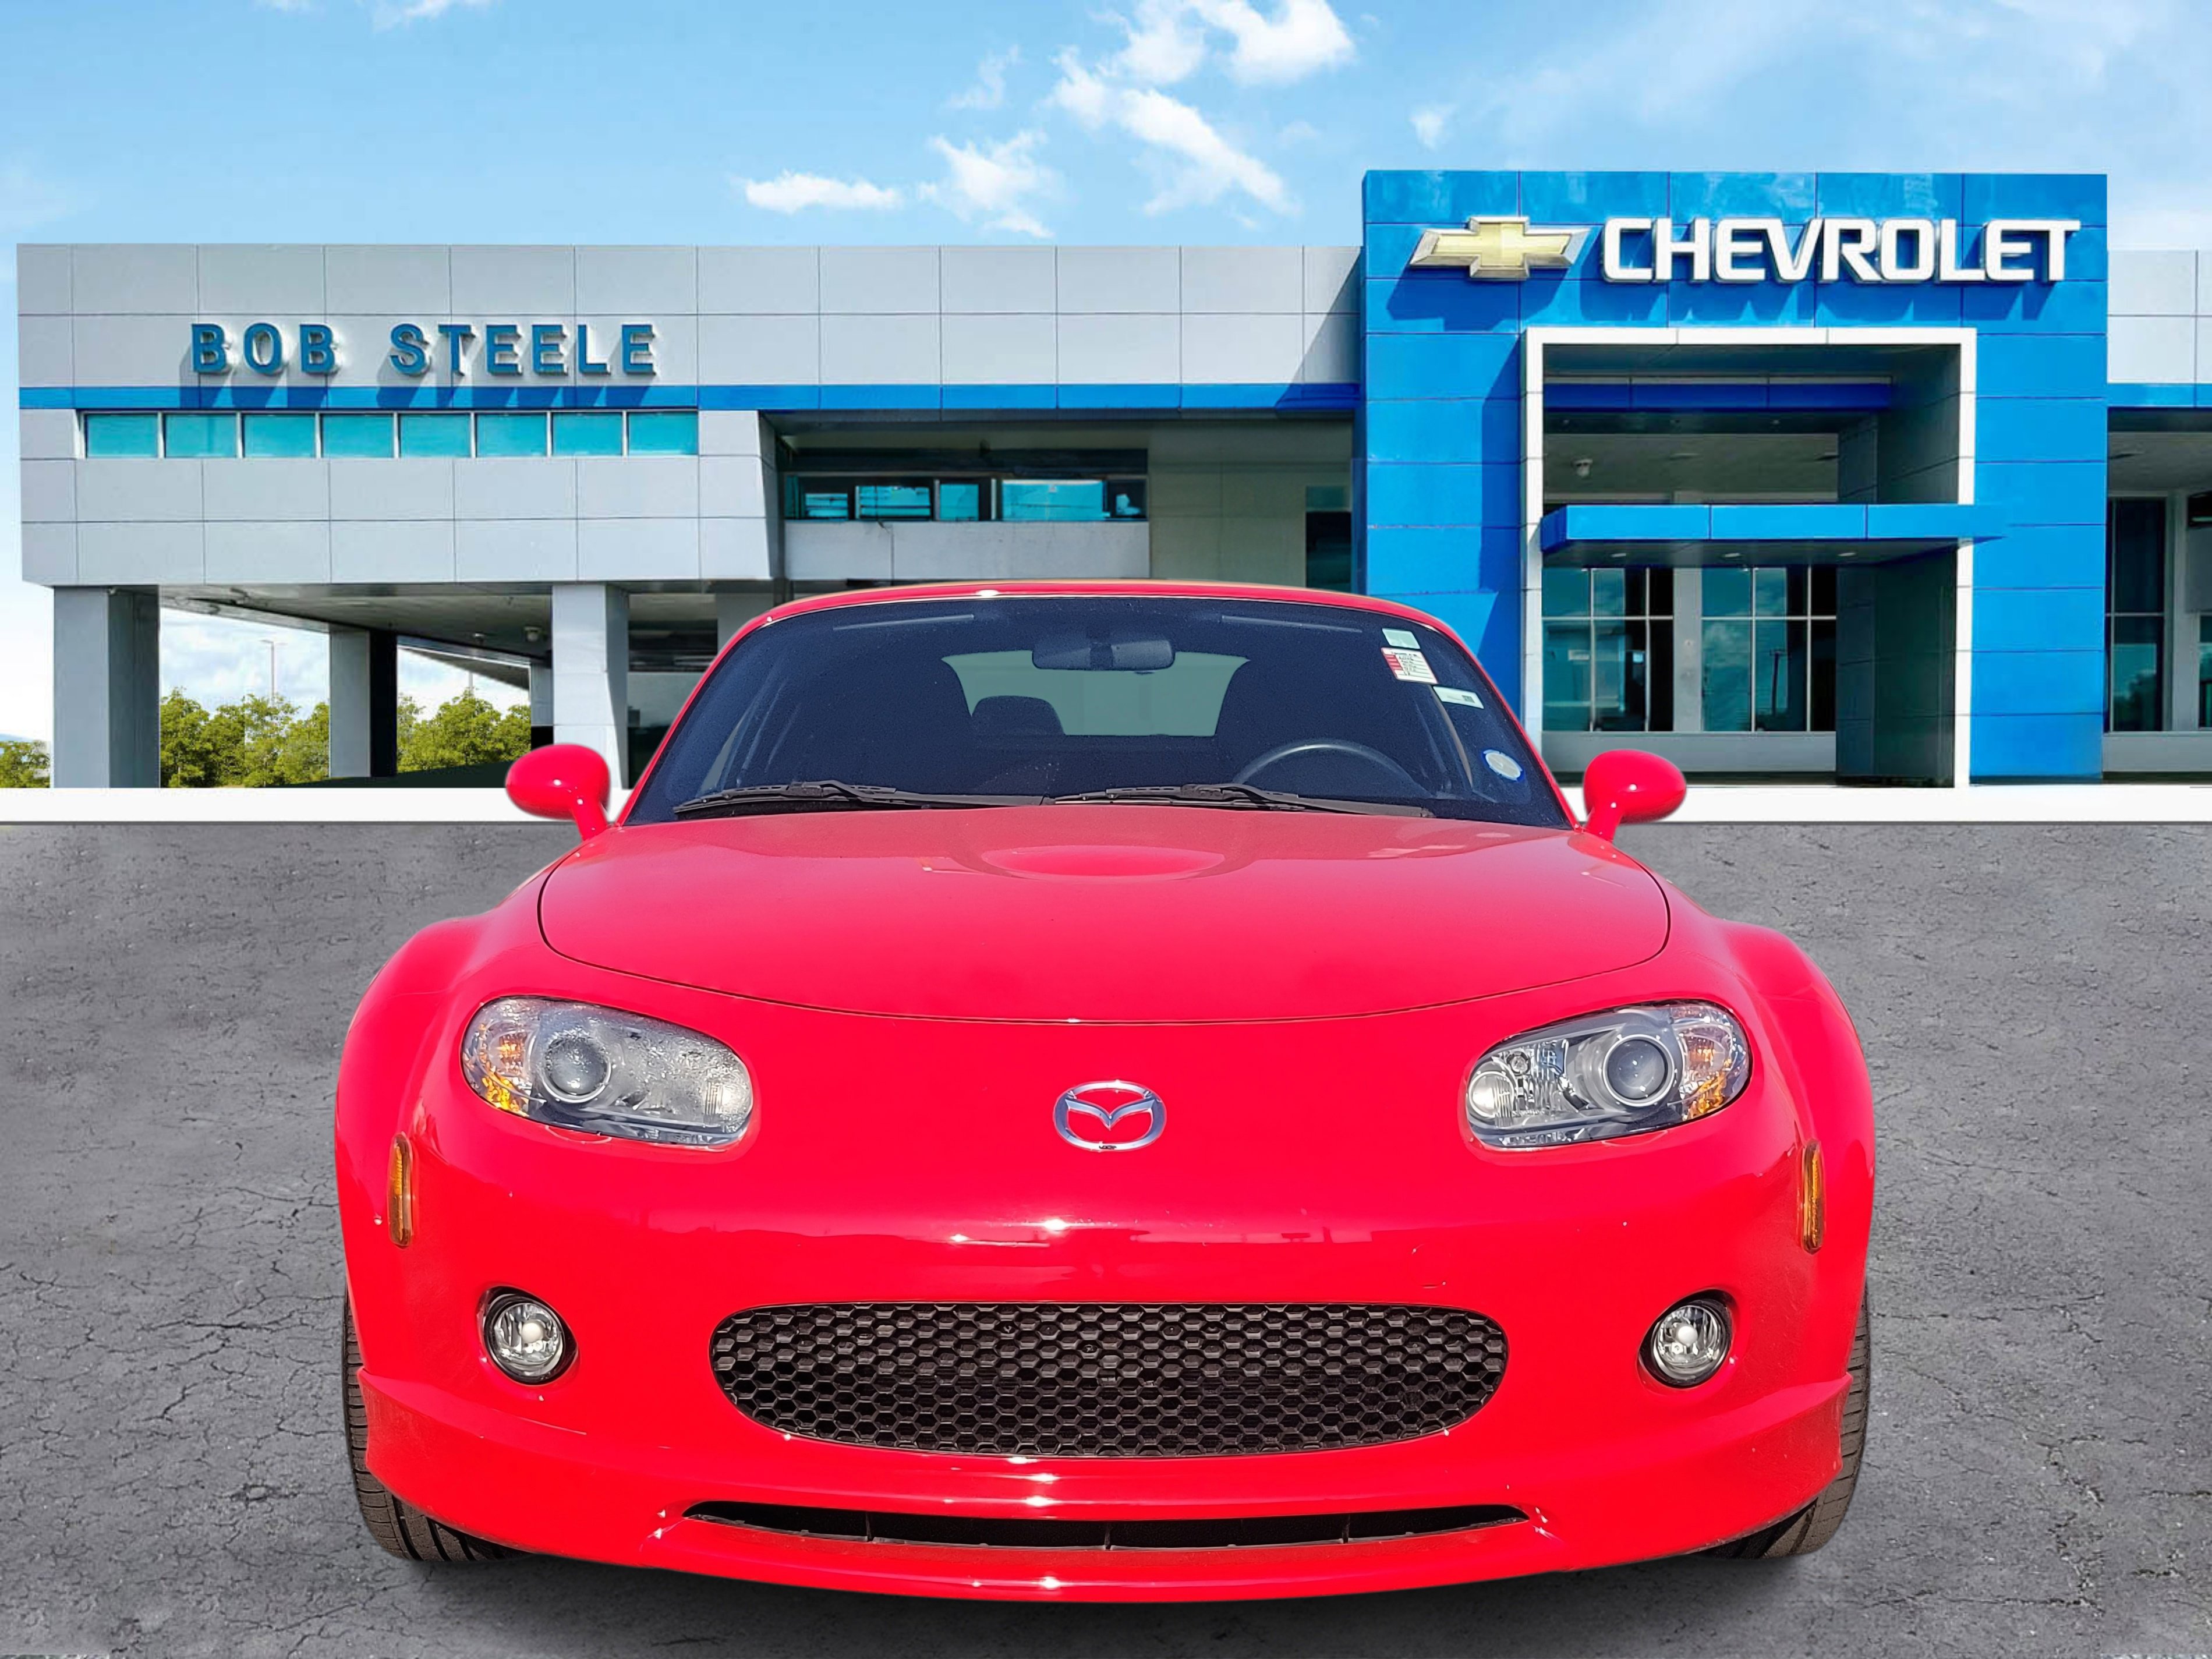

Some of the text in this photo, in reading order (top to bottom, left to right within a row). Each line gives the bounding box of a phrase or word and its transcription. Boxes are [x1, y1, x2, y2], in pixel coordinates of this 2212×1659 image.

[1602, 217, 2081, 282] CHEVROLET
[191, 323, 657, 377] BOB STEELE
